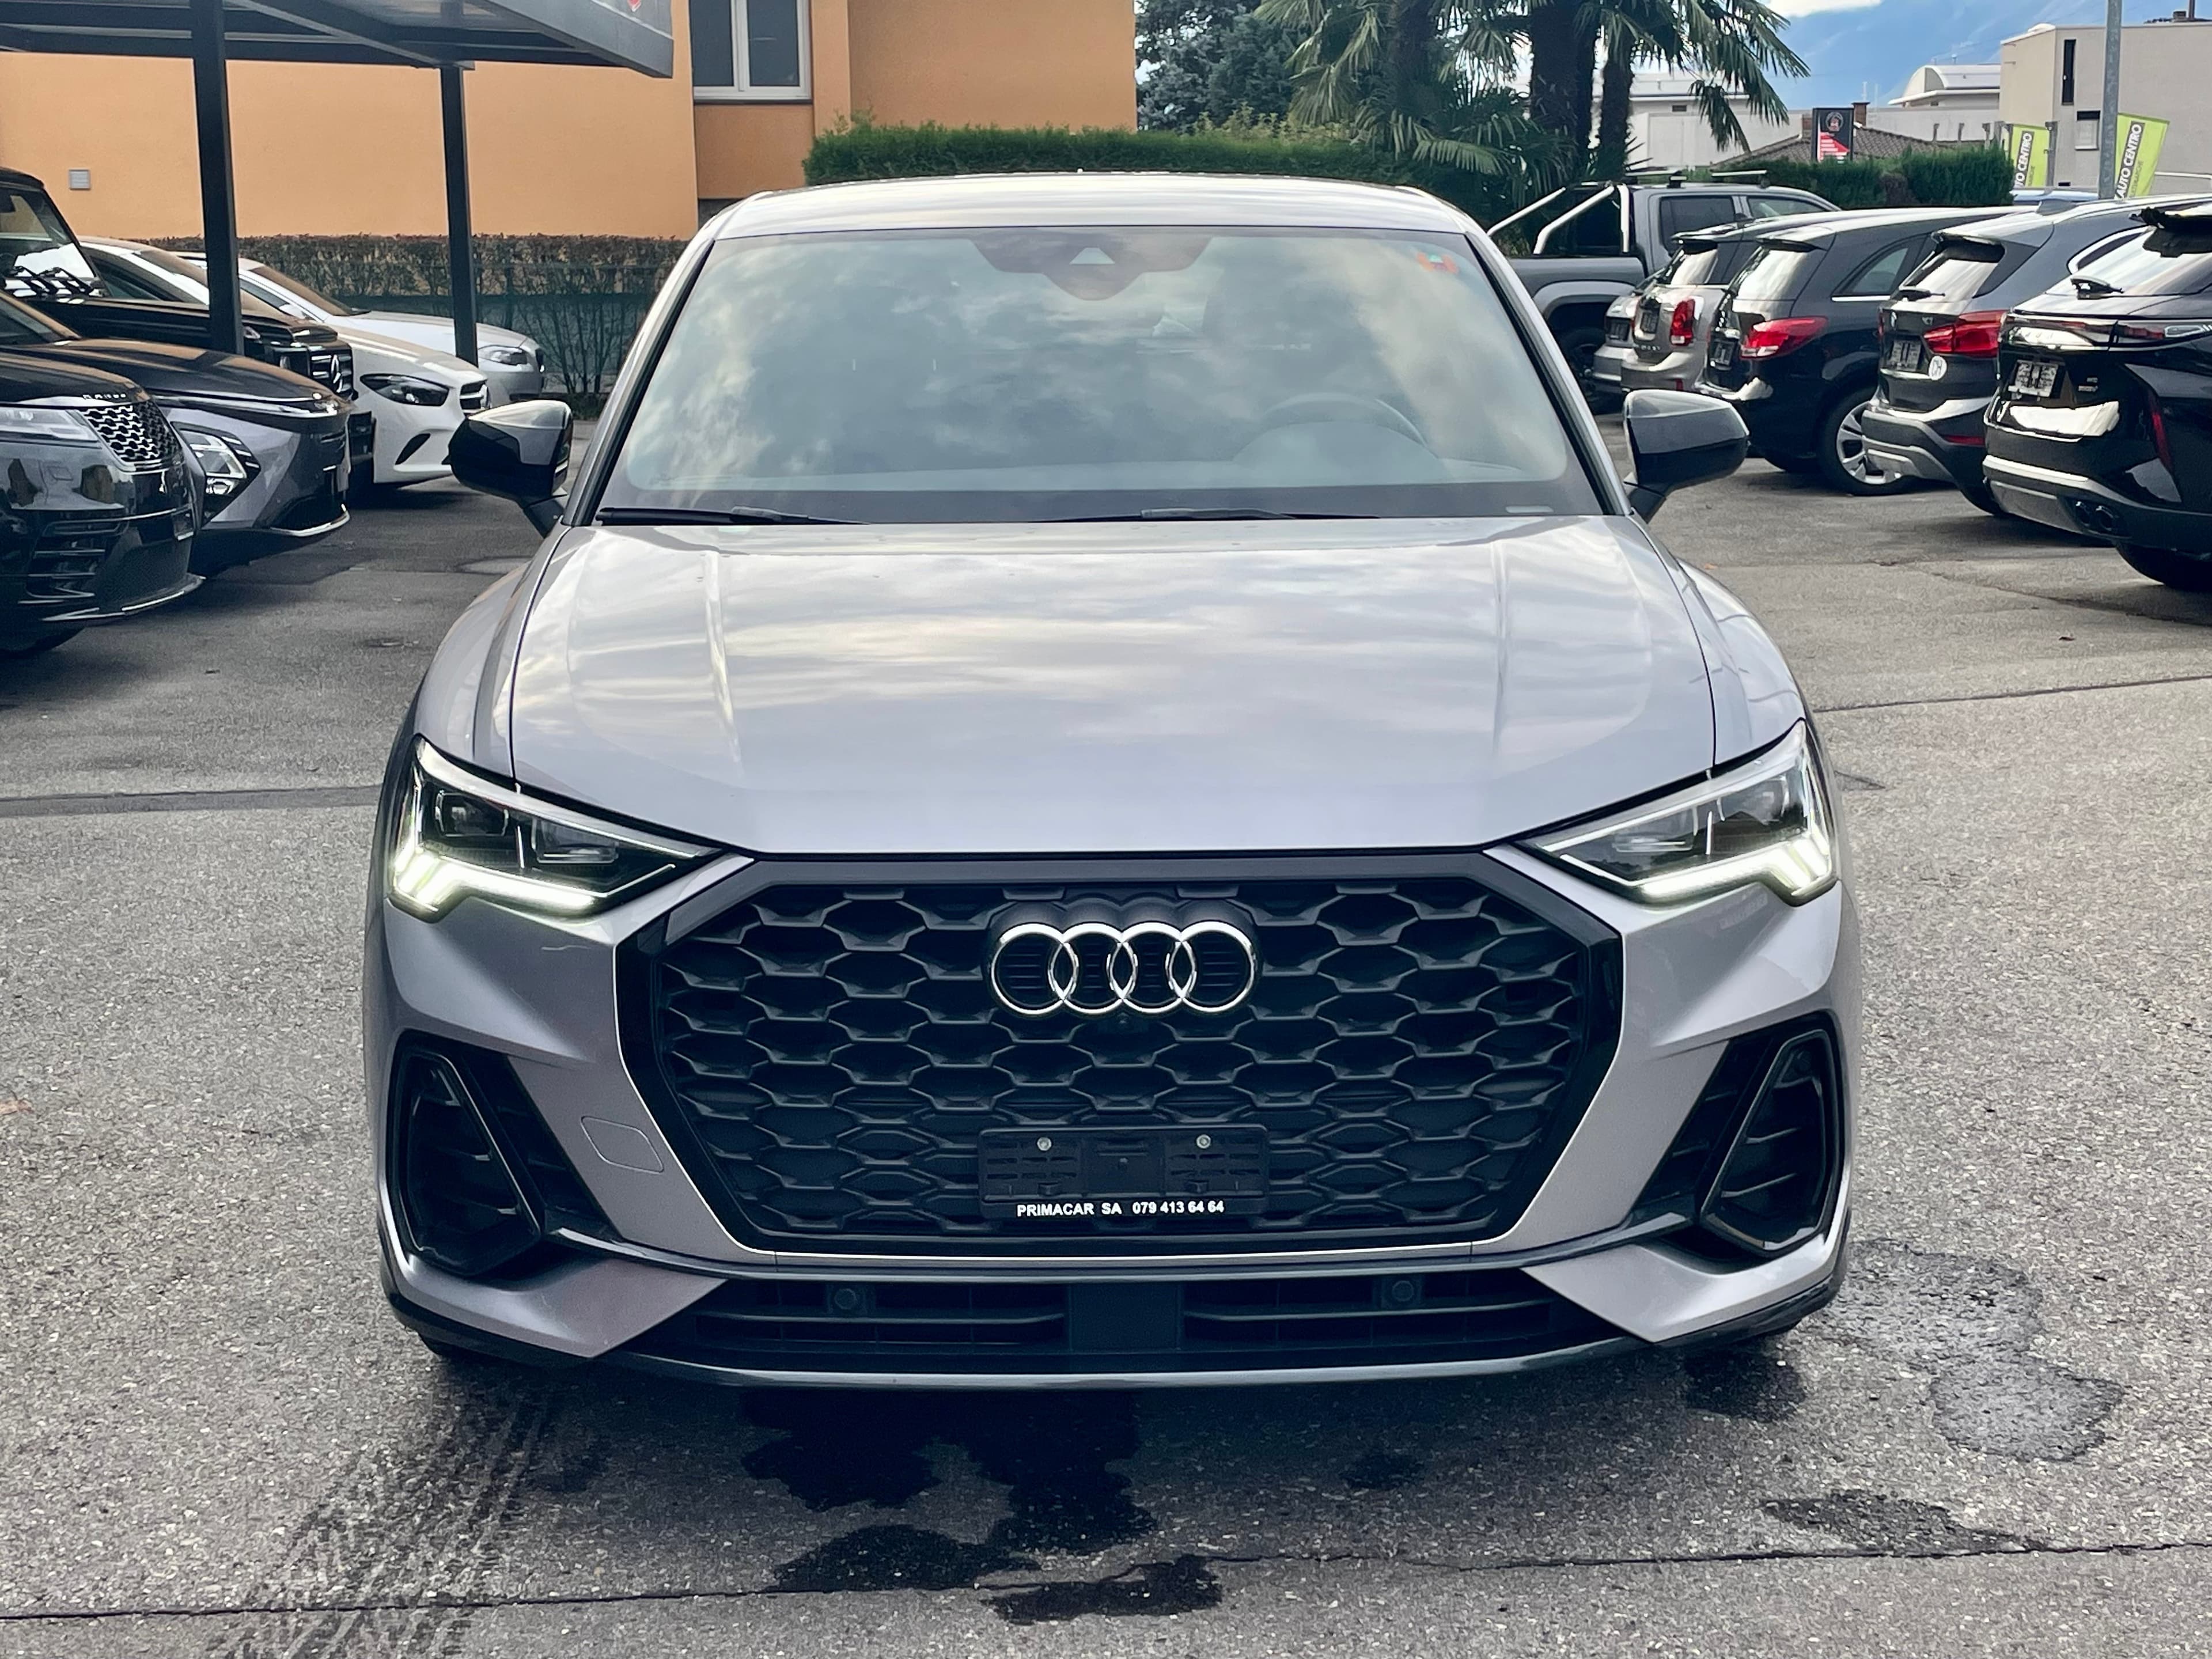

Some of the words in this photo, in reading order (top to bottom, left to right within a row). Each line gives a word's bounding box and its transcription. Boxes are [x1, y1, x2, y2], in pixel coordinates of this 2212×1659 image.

[2017, 132, 2032, 171] CENTRO
[2123, 123, 2142, 166] CENTRO
[1017, 1202, 1094, 1217] PRIMACAR
[1101, 1202, 1122, 1215] SA
[1132, 1202, 1156, 1214] 079
[1160, 1200, 1184, 1213] 413
[1188, 1200, 1204, 1213] 64
[1207, 1200, 1224, 1212] 64
